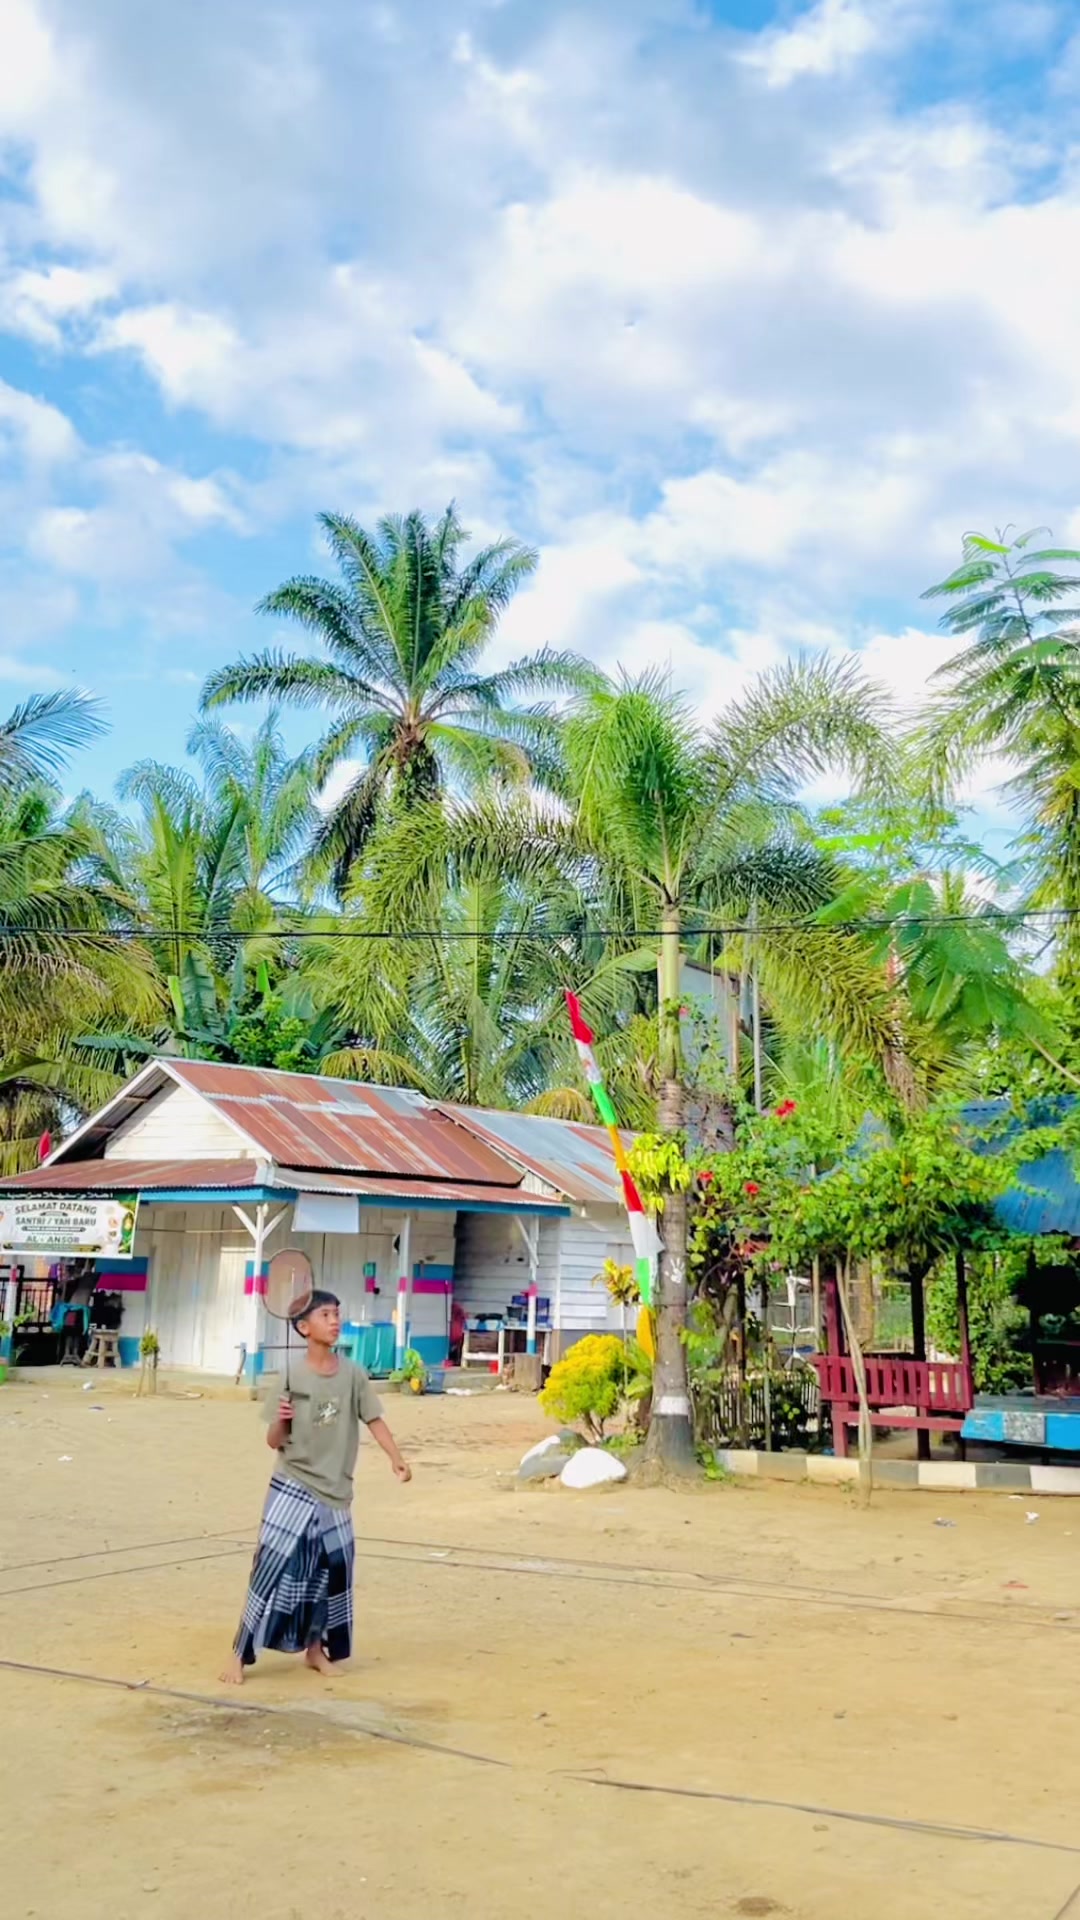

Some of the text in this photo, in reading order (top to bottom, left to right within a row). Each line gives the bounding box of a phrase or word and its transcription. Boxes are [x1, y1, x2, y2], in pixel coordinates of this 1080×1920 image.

[15, 1202, 97, 1215] SELAMAT DATANG
[15, 1217, 46, 1225] SANTRI
[73, 1218, 97, 1226] BARU
[47, 1236, 80, 1244] ANSOR
